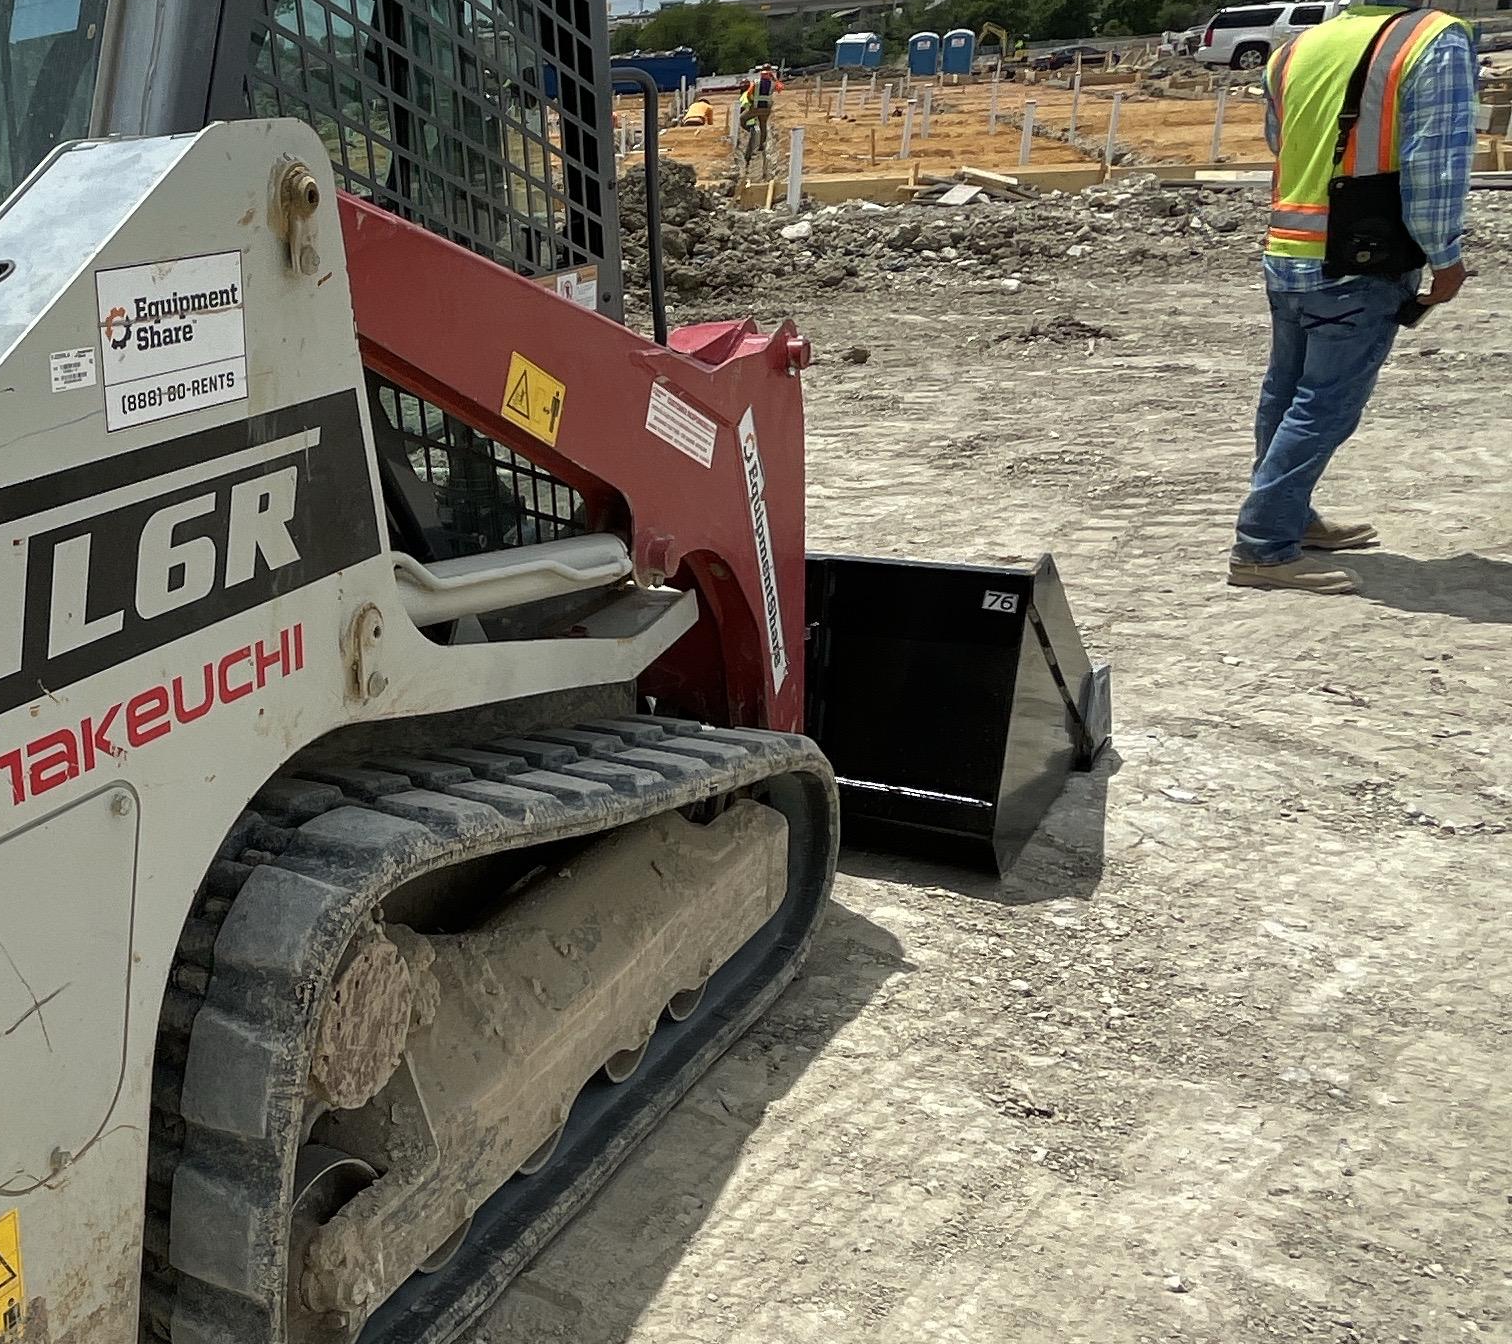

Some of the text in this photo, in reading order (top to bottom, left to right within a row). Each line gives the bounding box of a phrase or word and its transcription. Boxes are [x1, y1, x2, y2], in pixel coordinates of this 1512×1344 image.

[134, 283, 239, 324] Equipment
[121, 372, 235, 414] (888) 80-RENTS
[747, 463, 780, 669] EquipmentShare
[988, 592, 1014, 610] 76
